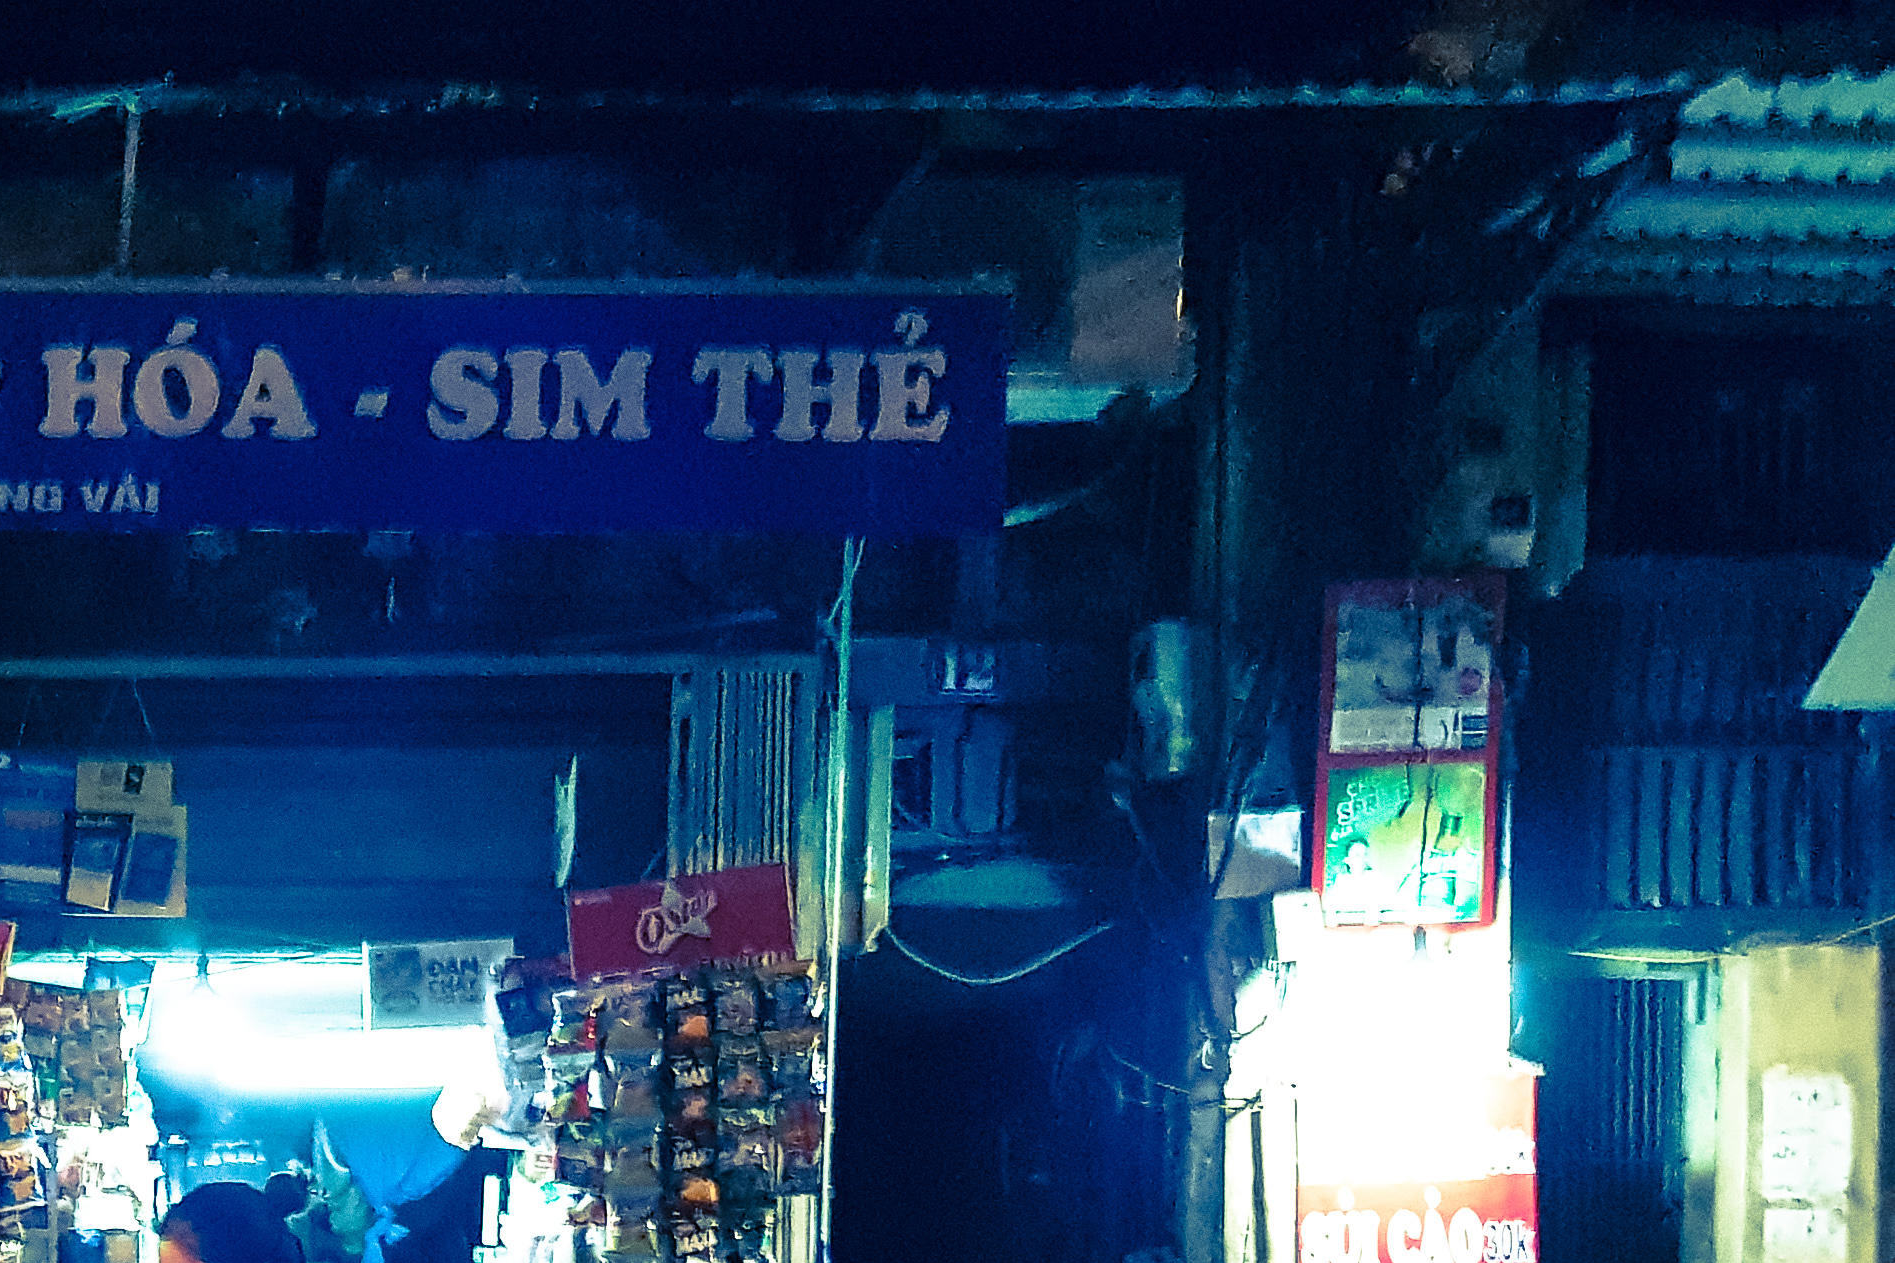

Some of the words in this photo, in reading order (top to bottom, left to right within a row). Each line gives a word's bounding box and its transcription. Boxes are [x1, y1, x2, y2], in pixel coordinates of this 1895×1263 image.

[38, 317, 317, 439] HÓA
[426, 345, 652, 442] SIM
[690, 307, 949, 442] THẺ
[1483, 1219, 1536, 1263] 30k
